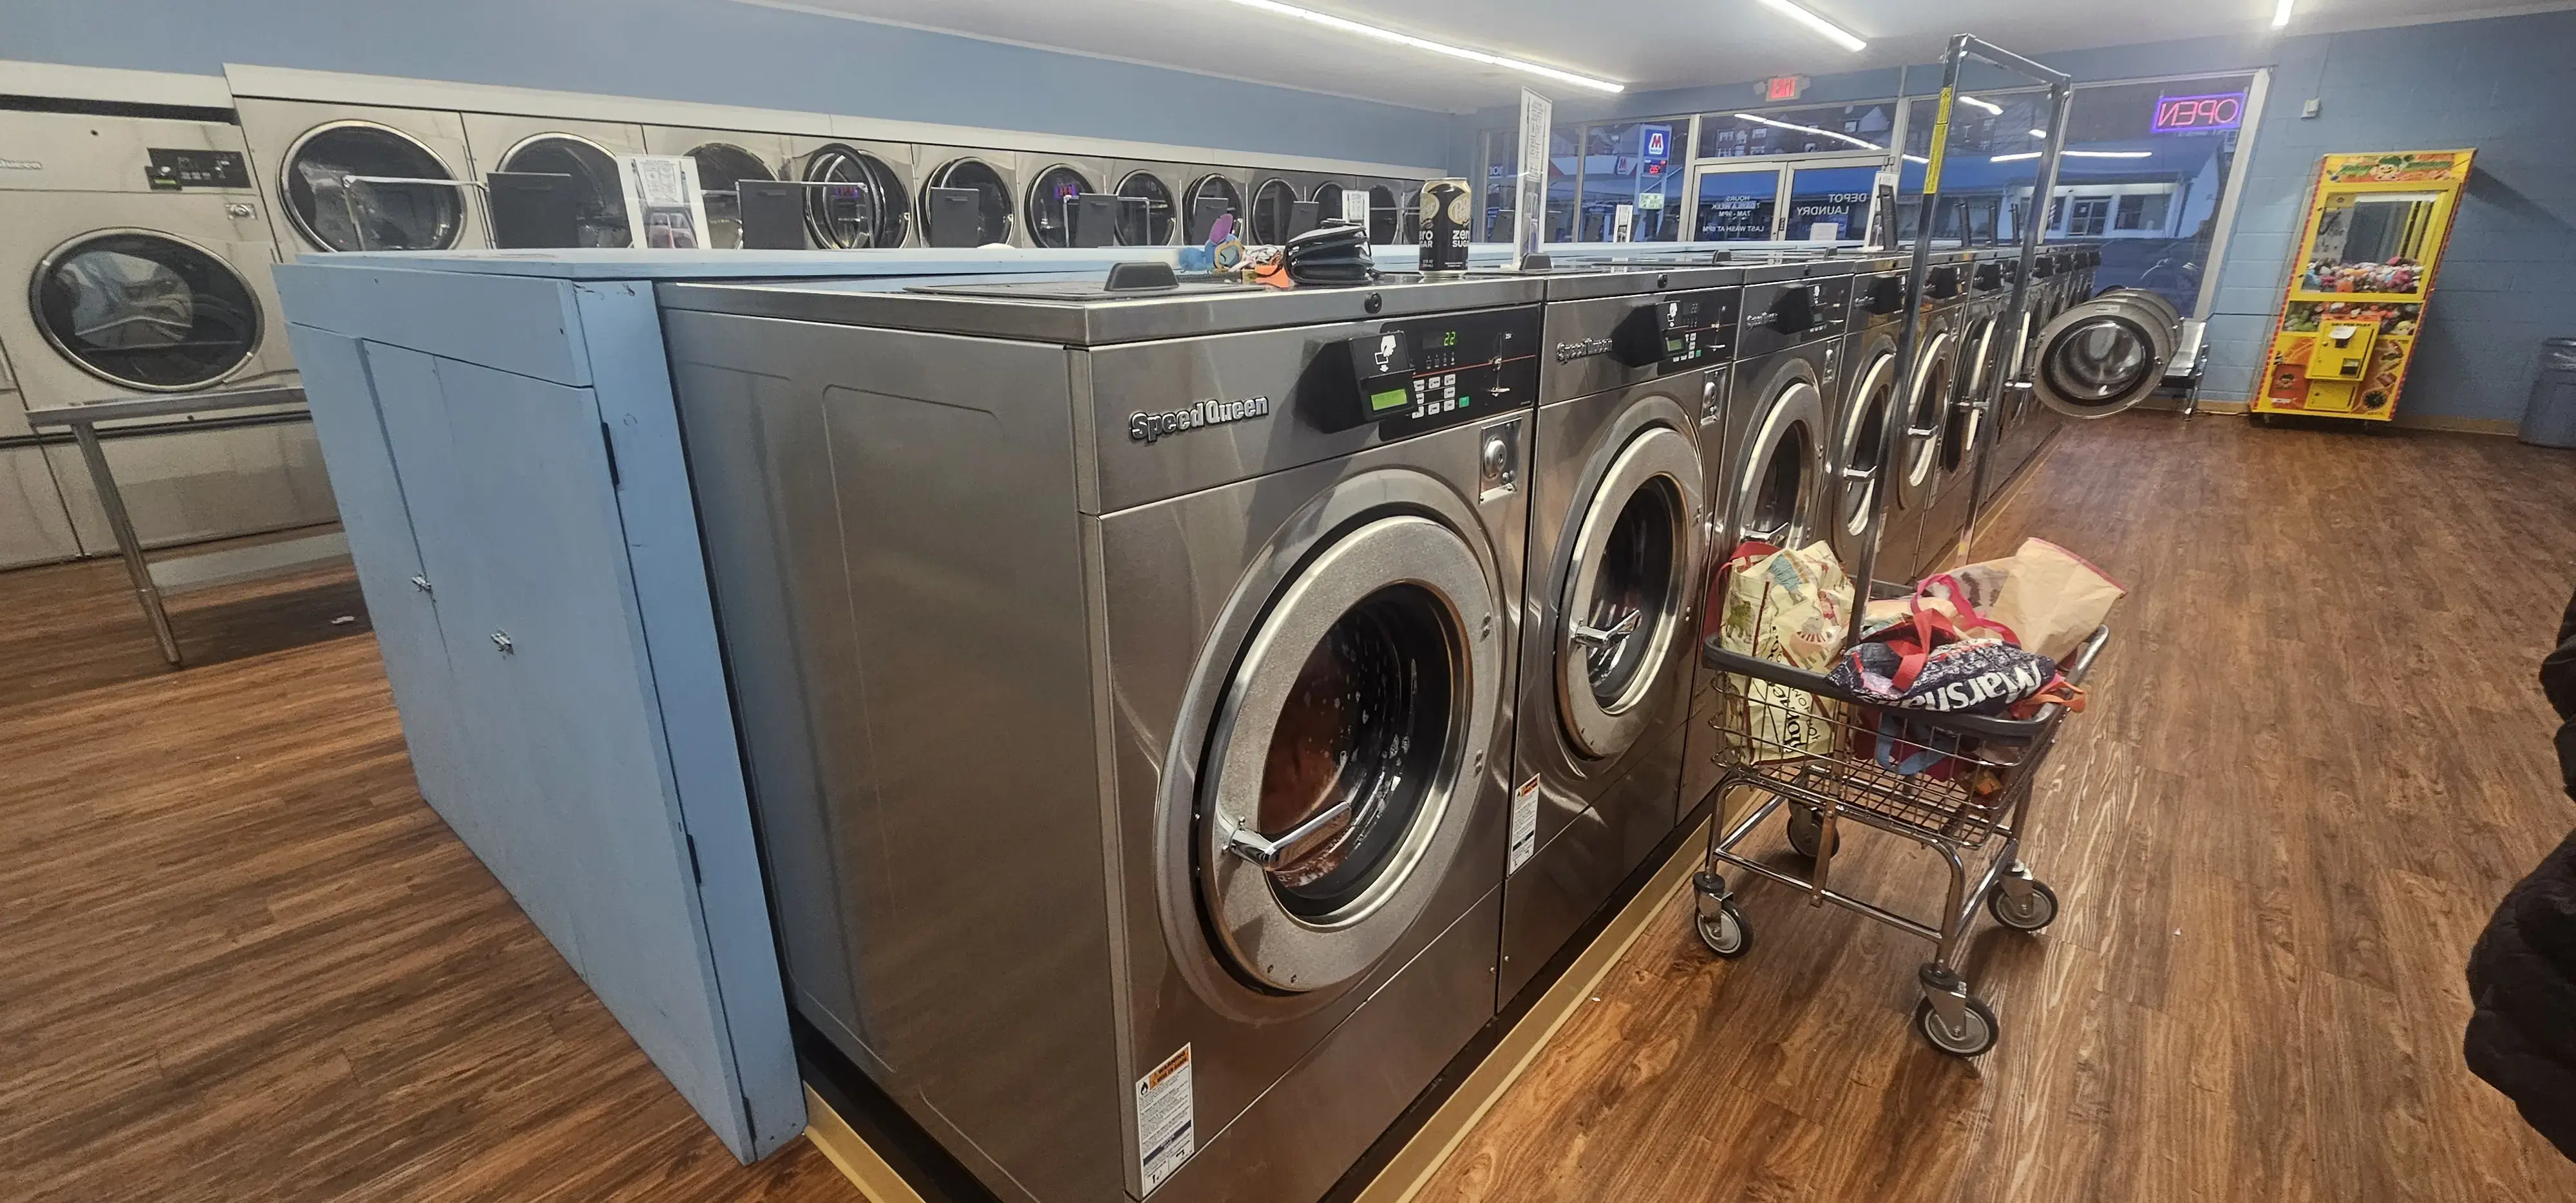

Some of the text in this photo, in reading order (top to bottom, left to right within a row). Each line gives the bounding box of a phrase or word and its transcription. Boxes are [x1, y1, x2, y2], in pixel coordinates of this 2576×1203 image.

[1452, 230, 1470, 240] zer
[1444, 332, 1456, 346] 22
[1131, 396, 1269, 442] Speed Queen
